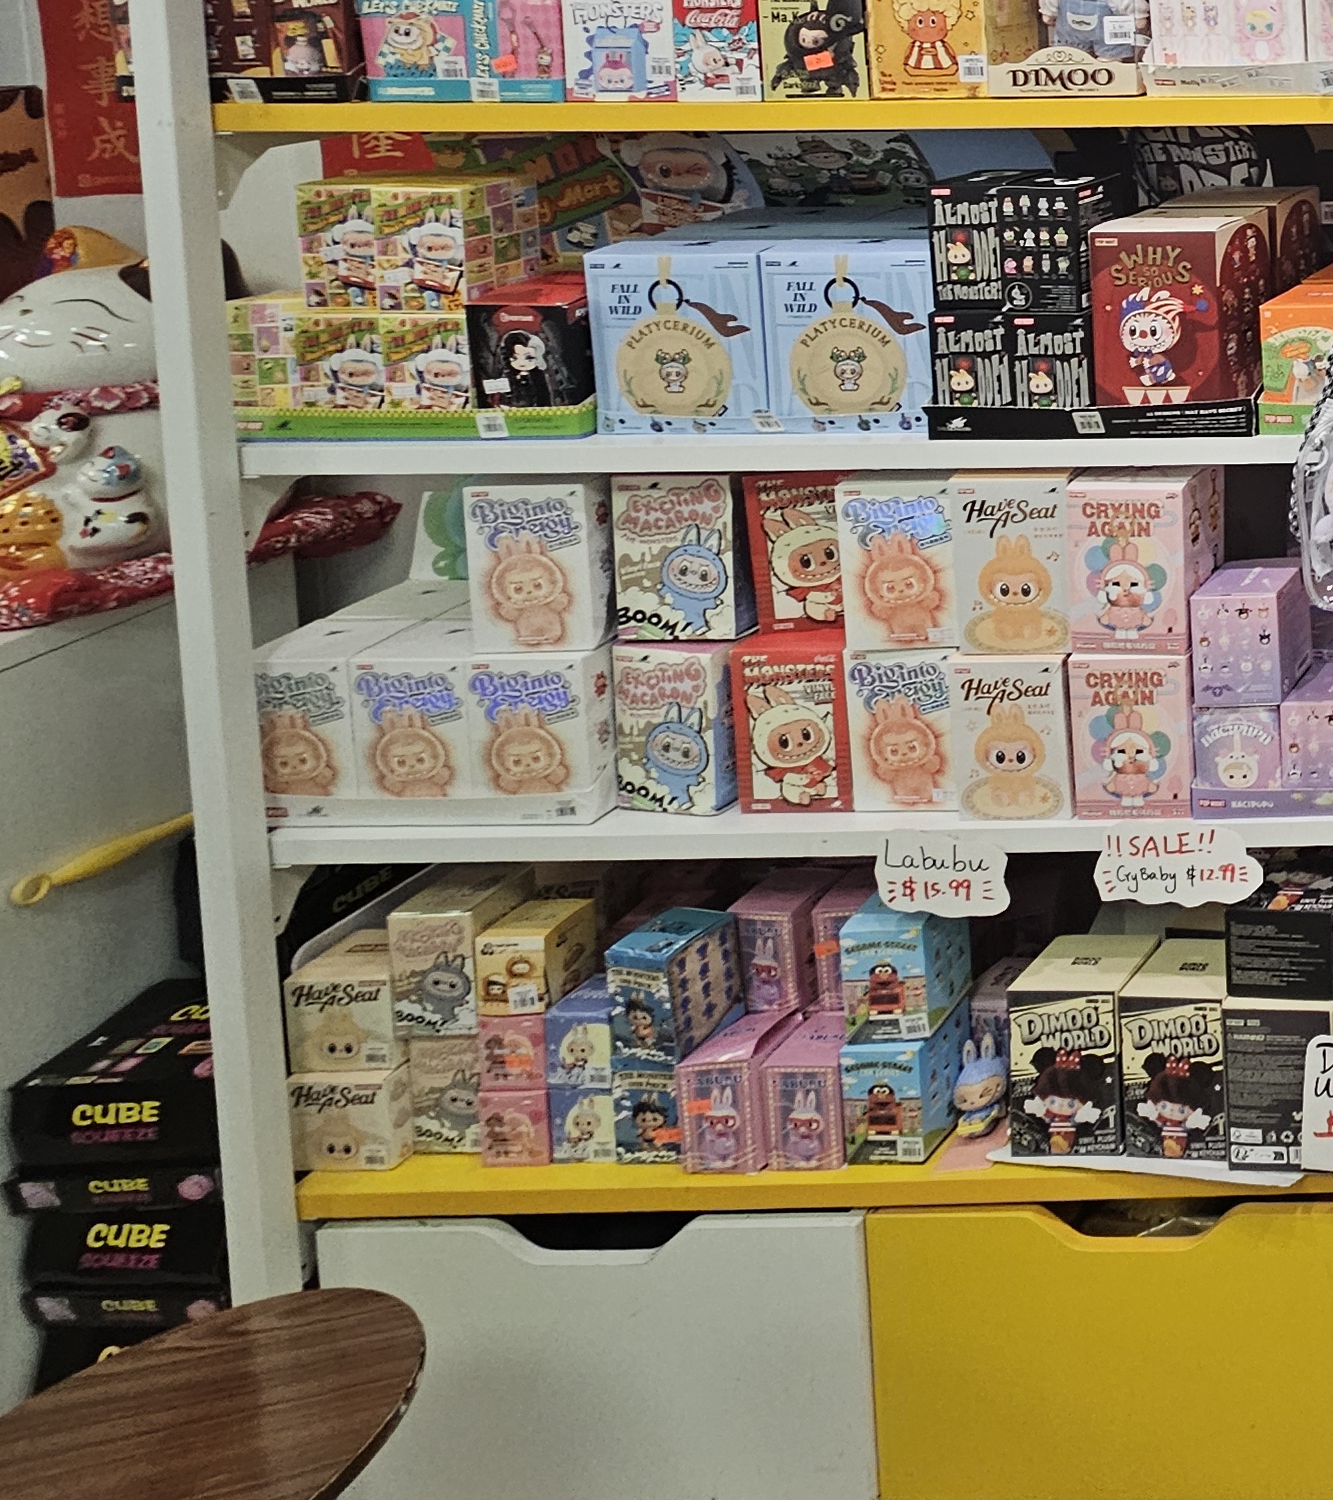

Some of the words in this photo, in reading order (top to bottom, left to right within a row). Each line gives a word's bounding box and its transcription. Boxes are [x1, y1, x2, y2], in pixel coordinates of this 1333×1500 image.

[934, 199, 998, 226] ALMOST
[1120, 243, 1182, 268] WHY
[1108, 262, 1192, 288] SERIOUS
[1142, 267, 1161, 277] SO
[611, 283, 640, 295] FALL
[785, 281, 816, 292] FALL
[608, 304, 642, 316] WILD
[619, 295, 630, 304] IN
[783, 302, 818, 314] WILD
[626, 319, 716, 350] PLATYCERIUM
[799, 316, 891, 348] PLATYCERIUM
[935, 326, 1003, 354] ALMOST
[1081, 501, 1161, 520] CRYING
[620, 510, 714, 536] MACARON
[1087, 521, 1152, 538] AGAIN
[617, 607, 692, 637] BOOM!
[1085, 670, 1163, 688] CRYING
[884, 839, 990, 873] Labubu
[1186, 862, 1237, 885] $12.99
[901, 876, 972, 902] $15.99
[71, 1101, 161, 1126] CUBE
[71, 1127, 158, 1144] SQUEEZE
[88, 1179, 150, 1194] CUBE
[86, 1223, 171, 1248] CUBE
